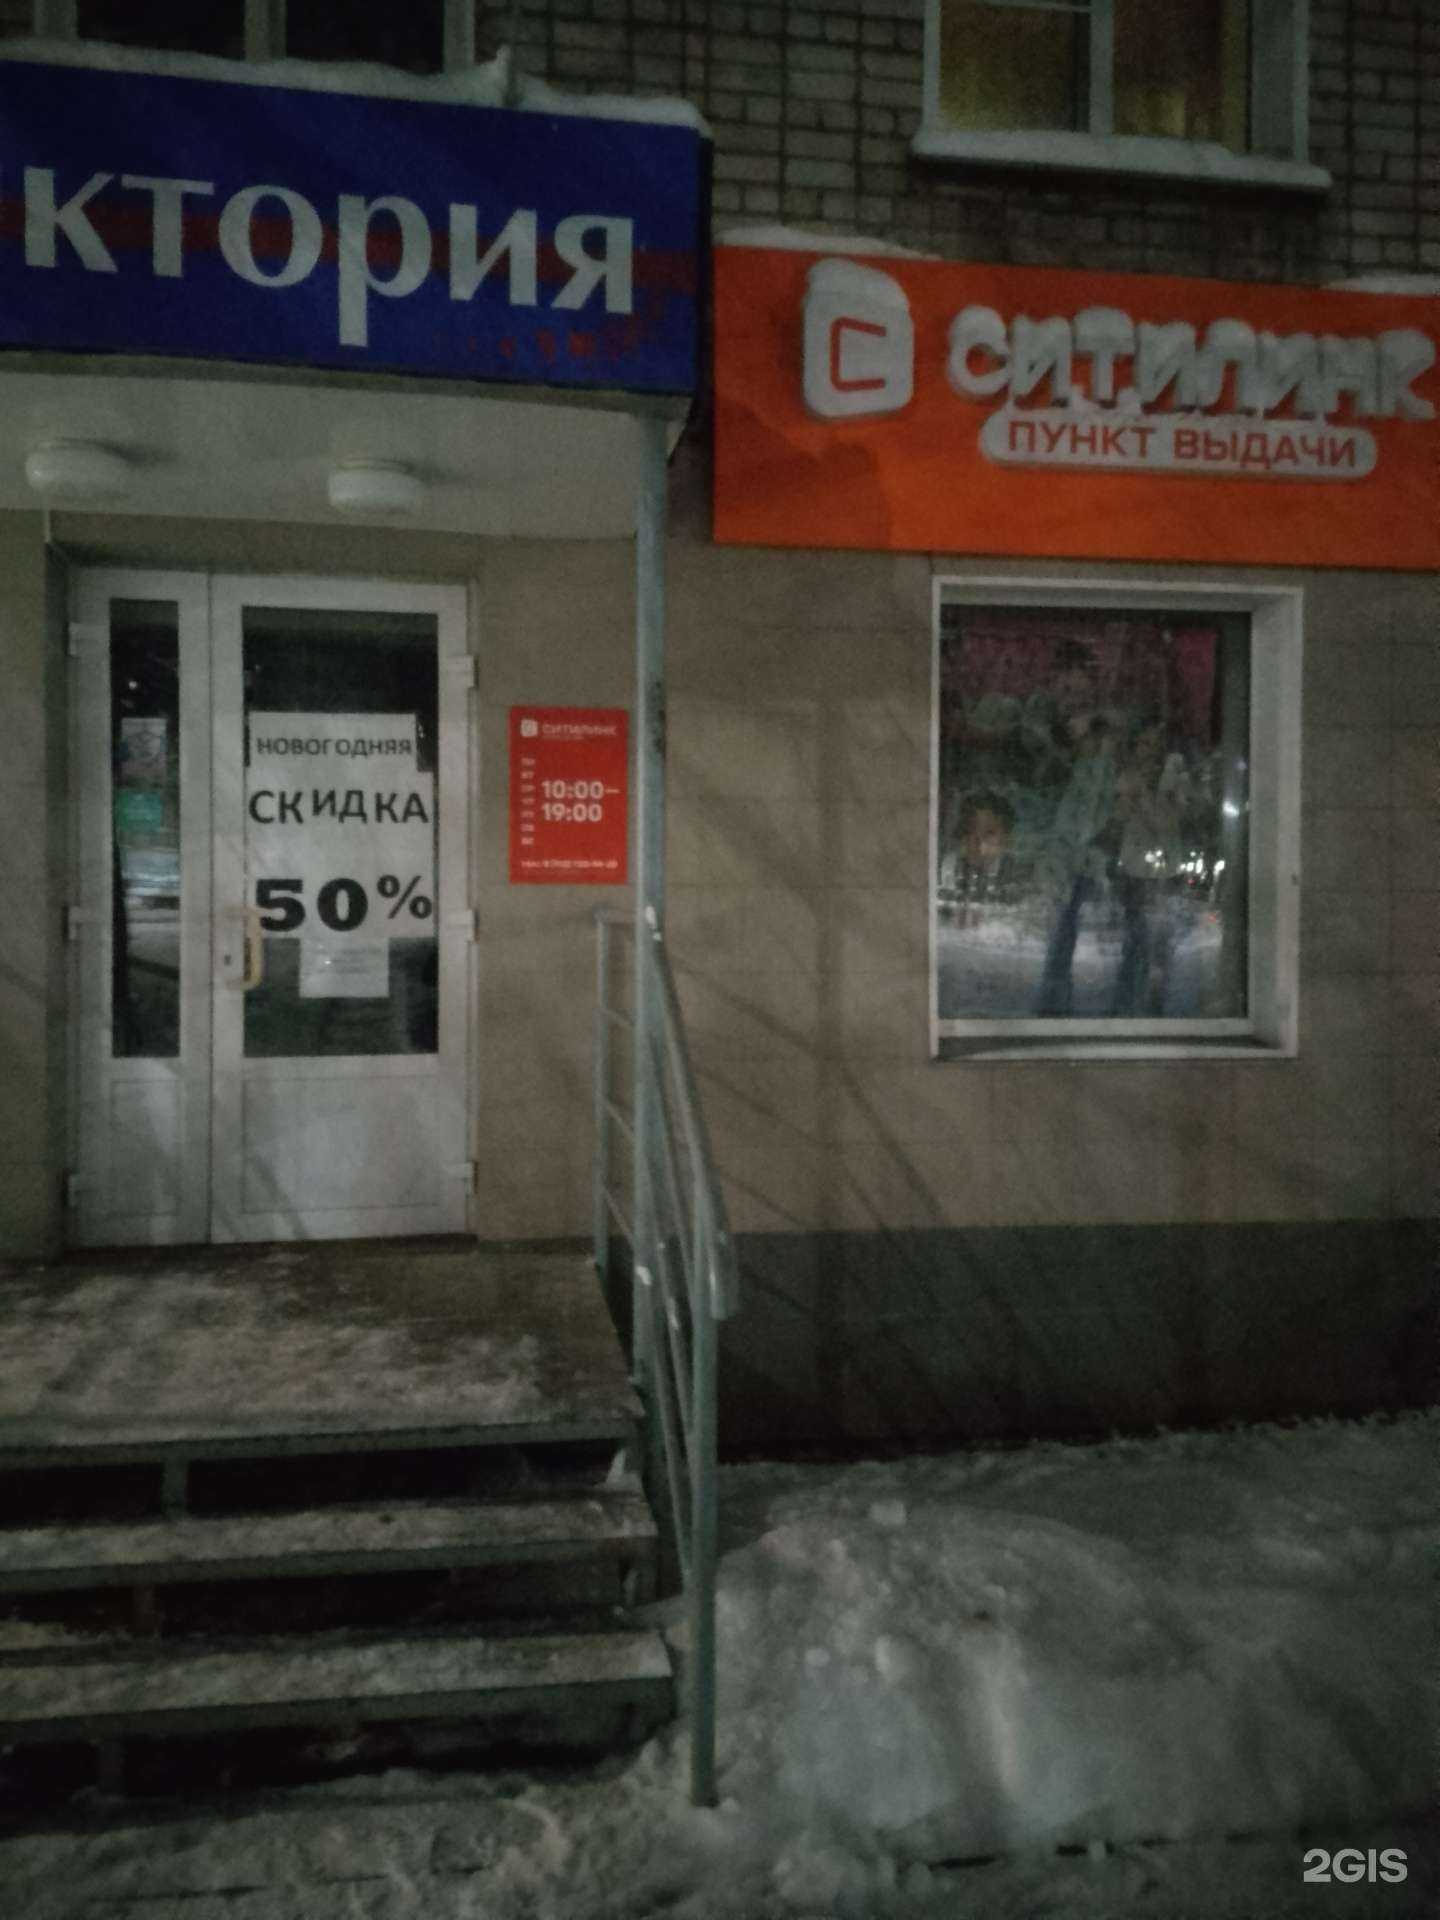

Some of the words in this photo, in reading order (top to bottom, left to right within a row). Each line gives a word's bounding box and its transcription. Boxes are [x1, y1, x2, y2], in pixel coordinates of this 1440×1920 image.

[947, 304, 1438, 421] СИТИЛИНК
[1007, 421, 1157, 457] ПУНКТ
[1173, 429, 1356, 469] ВЫДАЧИ
[257, 737, 412, 757] НОВОГОДНЯЯ
[249, 789, 430, 824] СКИДКА
[541, 802, 603, 823] 19:00
[256, 874, 433, 932] 50%
